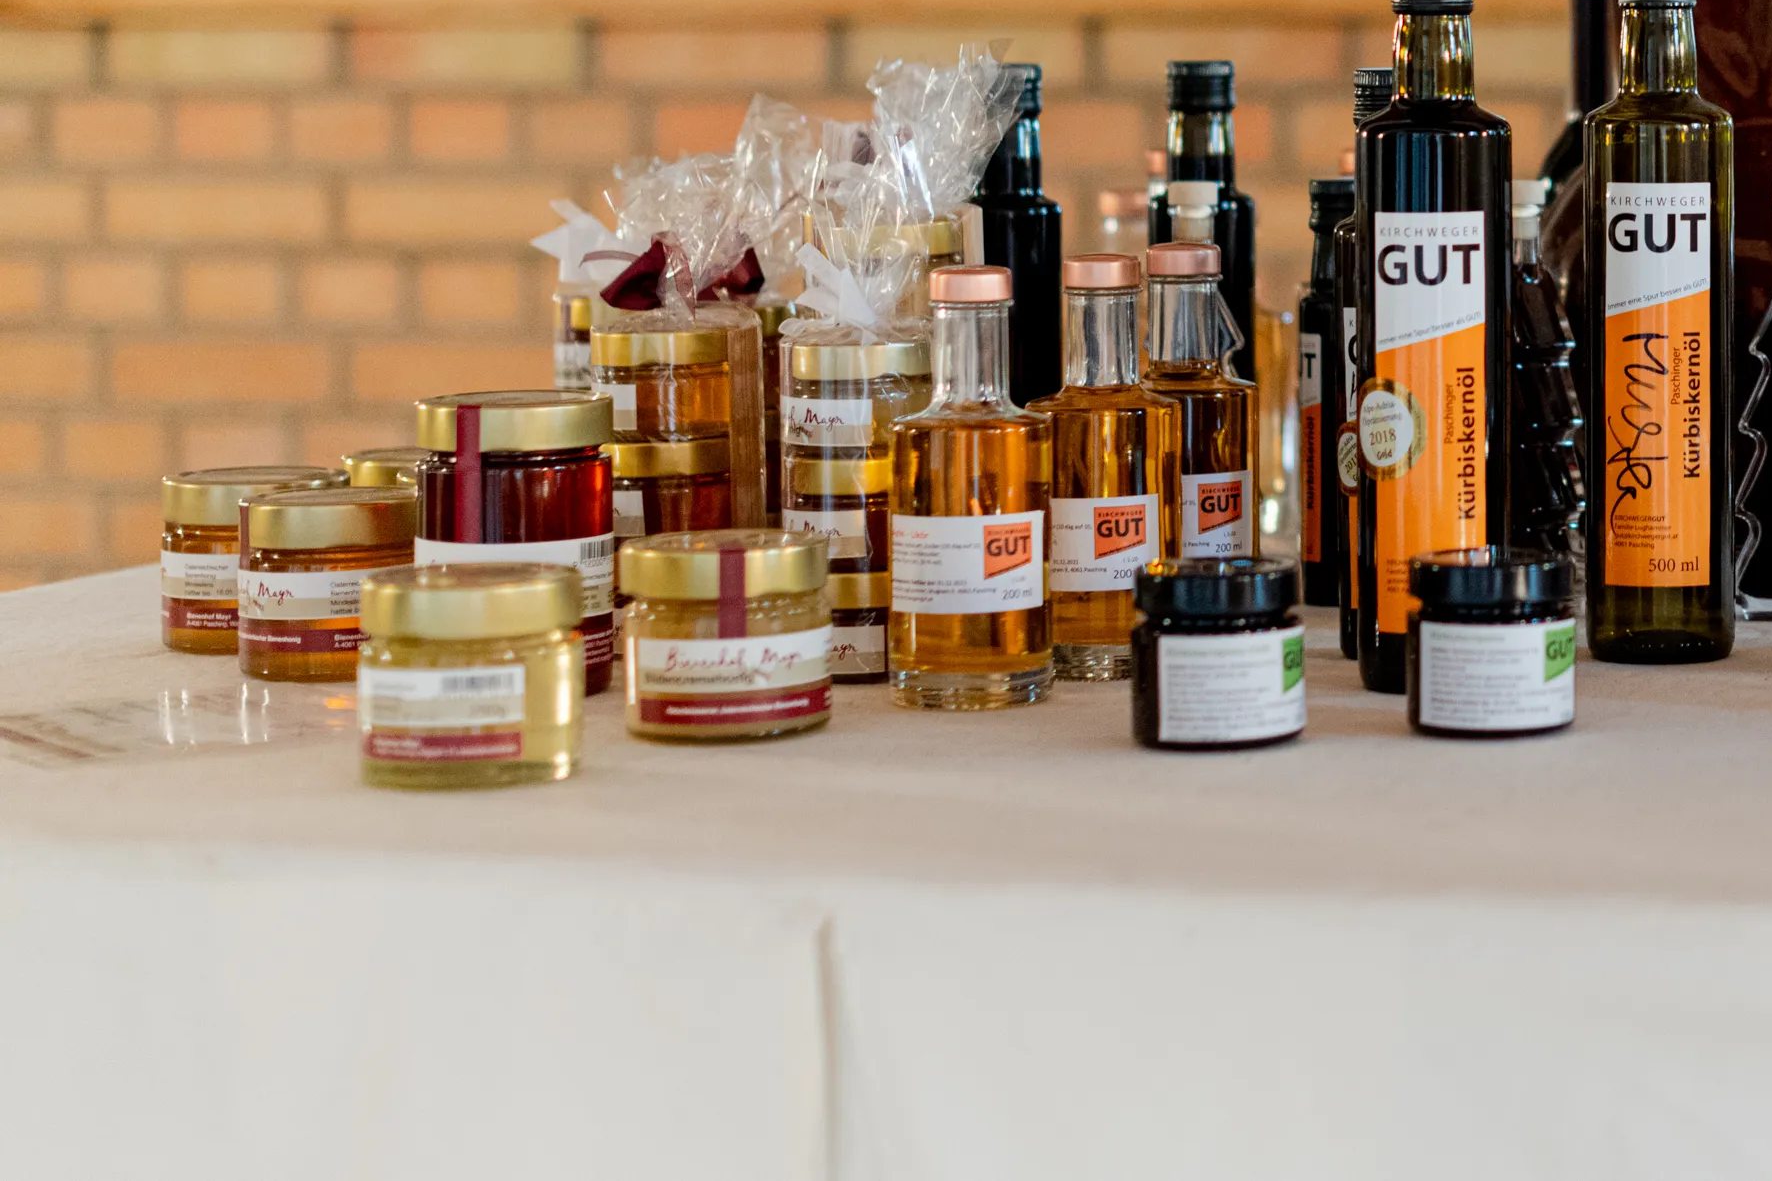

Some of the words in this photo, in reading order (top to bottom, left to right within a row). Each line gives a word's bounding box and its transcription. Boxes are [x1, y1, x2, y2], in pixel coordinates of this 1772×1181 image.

[1610, 196, 1705, 207] KIRCHWEGER
[1379, 226, 1479, 237] KIRCHWEGER
[1608, 213, 1706, 253] GUT
[1377, 243, 1480, 286] GUT
[1628, 297, 1642, 306] eine
[1643, 292, 1659, 304] Spur
[1660, 286, 1682, 298] besser
[1683, 282, 1692, 292] als
[1413, 327, 1430, 337] Spur
[1431, 320, 1454, 331] besser
[1670, 346, 1683, 405] Paschinger
[1444, 383, 1456, 444] Paschinger
[1683, 332, 1701, 479] Kürbiskernöl
[1369, 428, 1396, 446] 2018
[1456, 367, 1476, 520] Kürbiskernöl
[1376, 448, 1393, 461] Gold
[1200, 493, 1241, 513] GUT
[1097, 517, 1143, 538] GUT
[986, 535, 1030, 557] GUT
[1215, 543, 1232, 553] 200
[1232, 542, 1242, 552] ml
[1628, 541, 1655, 549] Pasching
[1648, 558, 1676, 572] 500
[1680, 556, 1699, 572] ml
[1113, 569, 1132, 579] 200
[257, 581, 294, 606] Mayr
[1002, 589, 1020, 601] 200
[1022, 587, 1033, 598] ml
[831, 642, 858, 661] ayr
